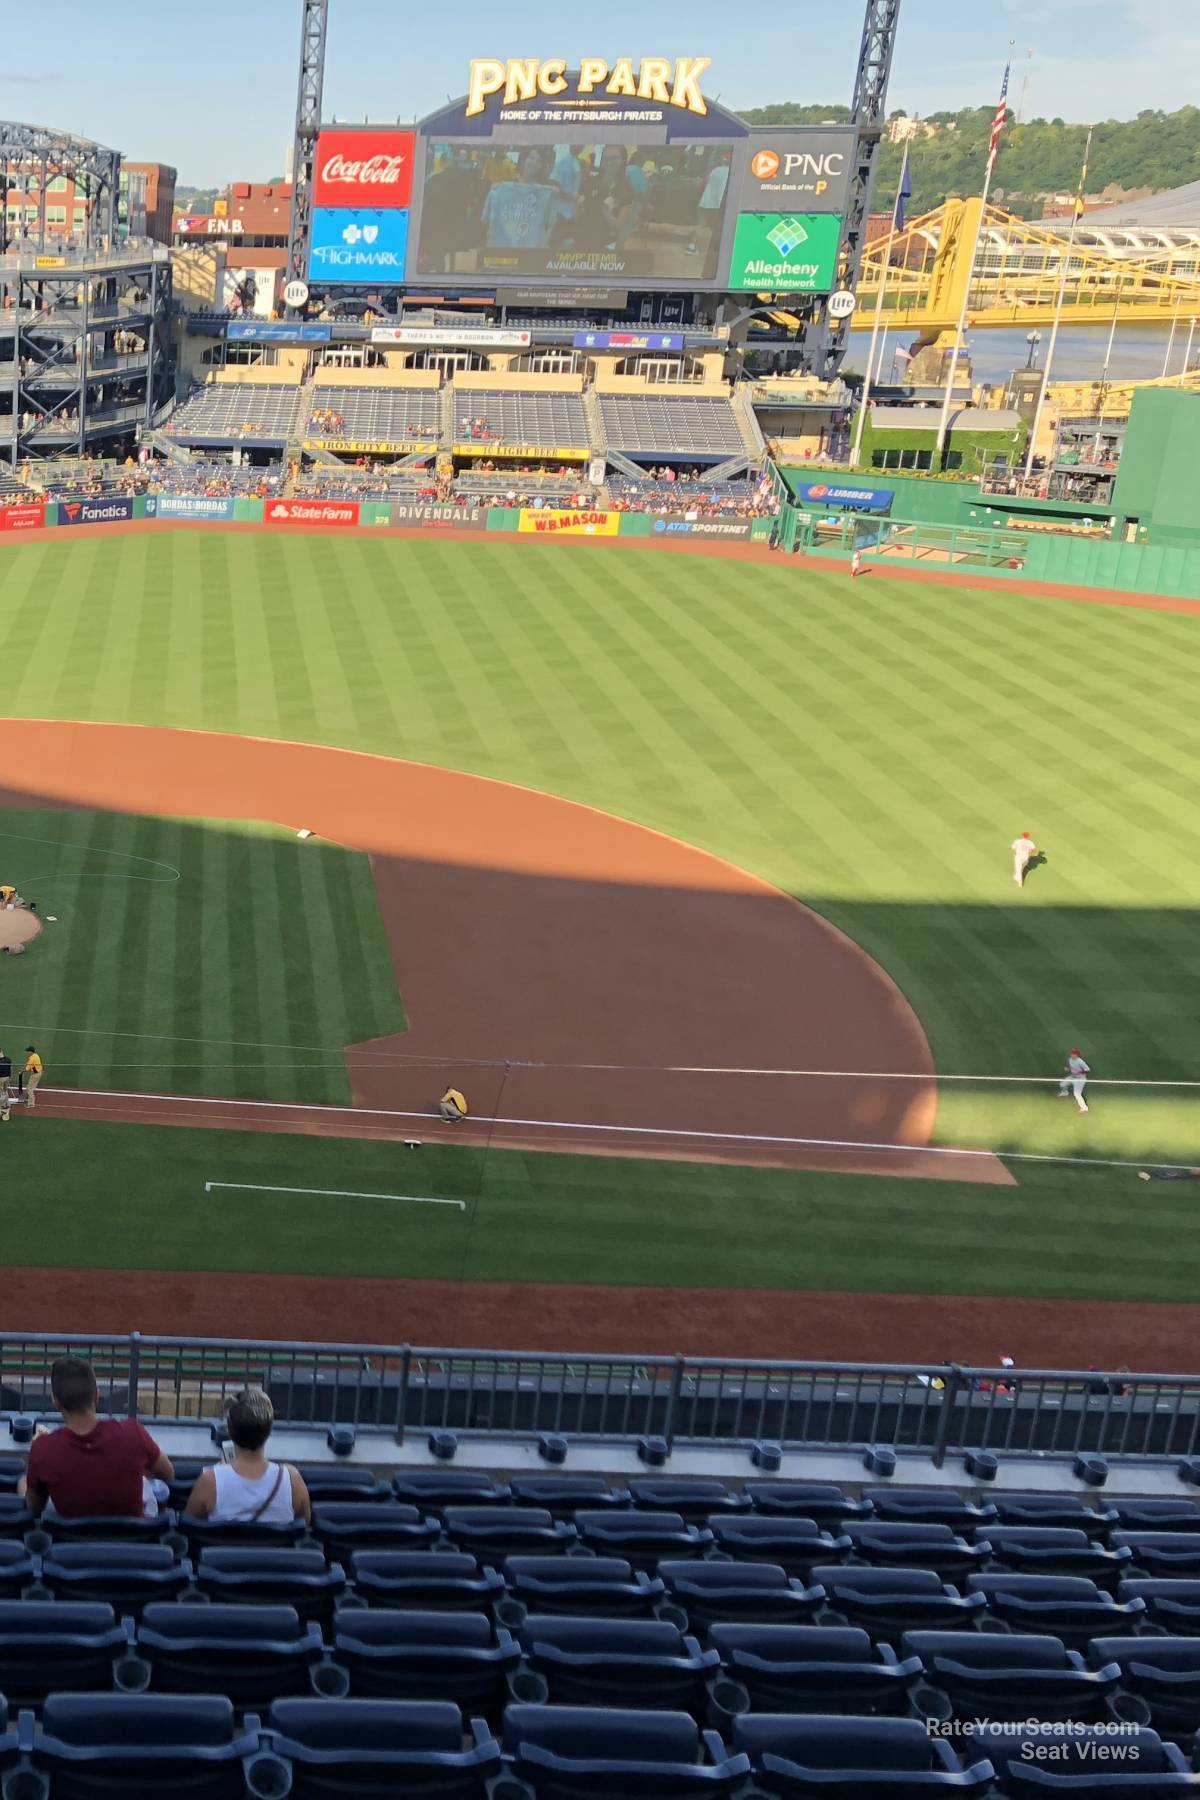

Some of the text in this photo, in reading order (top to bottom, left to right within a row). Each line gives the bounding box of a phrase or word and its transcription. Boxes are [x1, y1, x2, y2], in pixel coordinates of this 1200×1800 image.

[466, 57, 711, 116] PNC PARK
[500, 110, 663, 121] HOME OF THE PITTSBURGH PIRATES
[322, 154, 406, 184] Coca-Cola
[784, 154, 843, 176] PNC
[761, 183, 781, 191] Official
[797, 183, 804, 191] of
[314, 246, 402, 266] HIGHMARK
[546, 261, 625, 271] AVAILABLE NOW
[745, 260, 819, 277] Allegheny
[743, 278, 815, 288] Health Network
[287, 287, 305, 299] Lite
[832, 298, 853, 310] Lite
[323, 442, 417, 452] IRON CITY BEER
[498, 447, 531, 456] LIGHT
[827, 489, 874, 500] LUMBER
[161, 499, 192, 510] BORDAS
[195, 500, 227, 511] BORDAS
[82, 505, 127, 520] Fanatics
[399, 506, 479, 521] RIVENDALE
[560, 513, 608, 528] MASON
[692, 524, 748, 534] SPORTSNET
